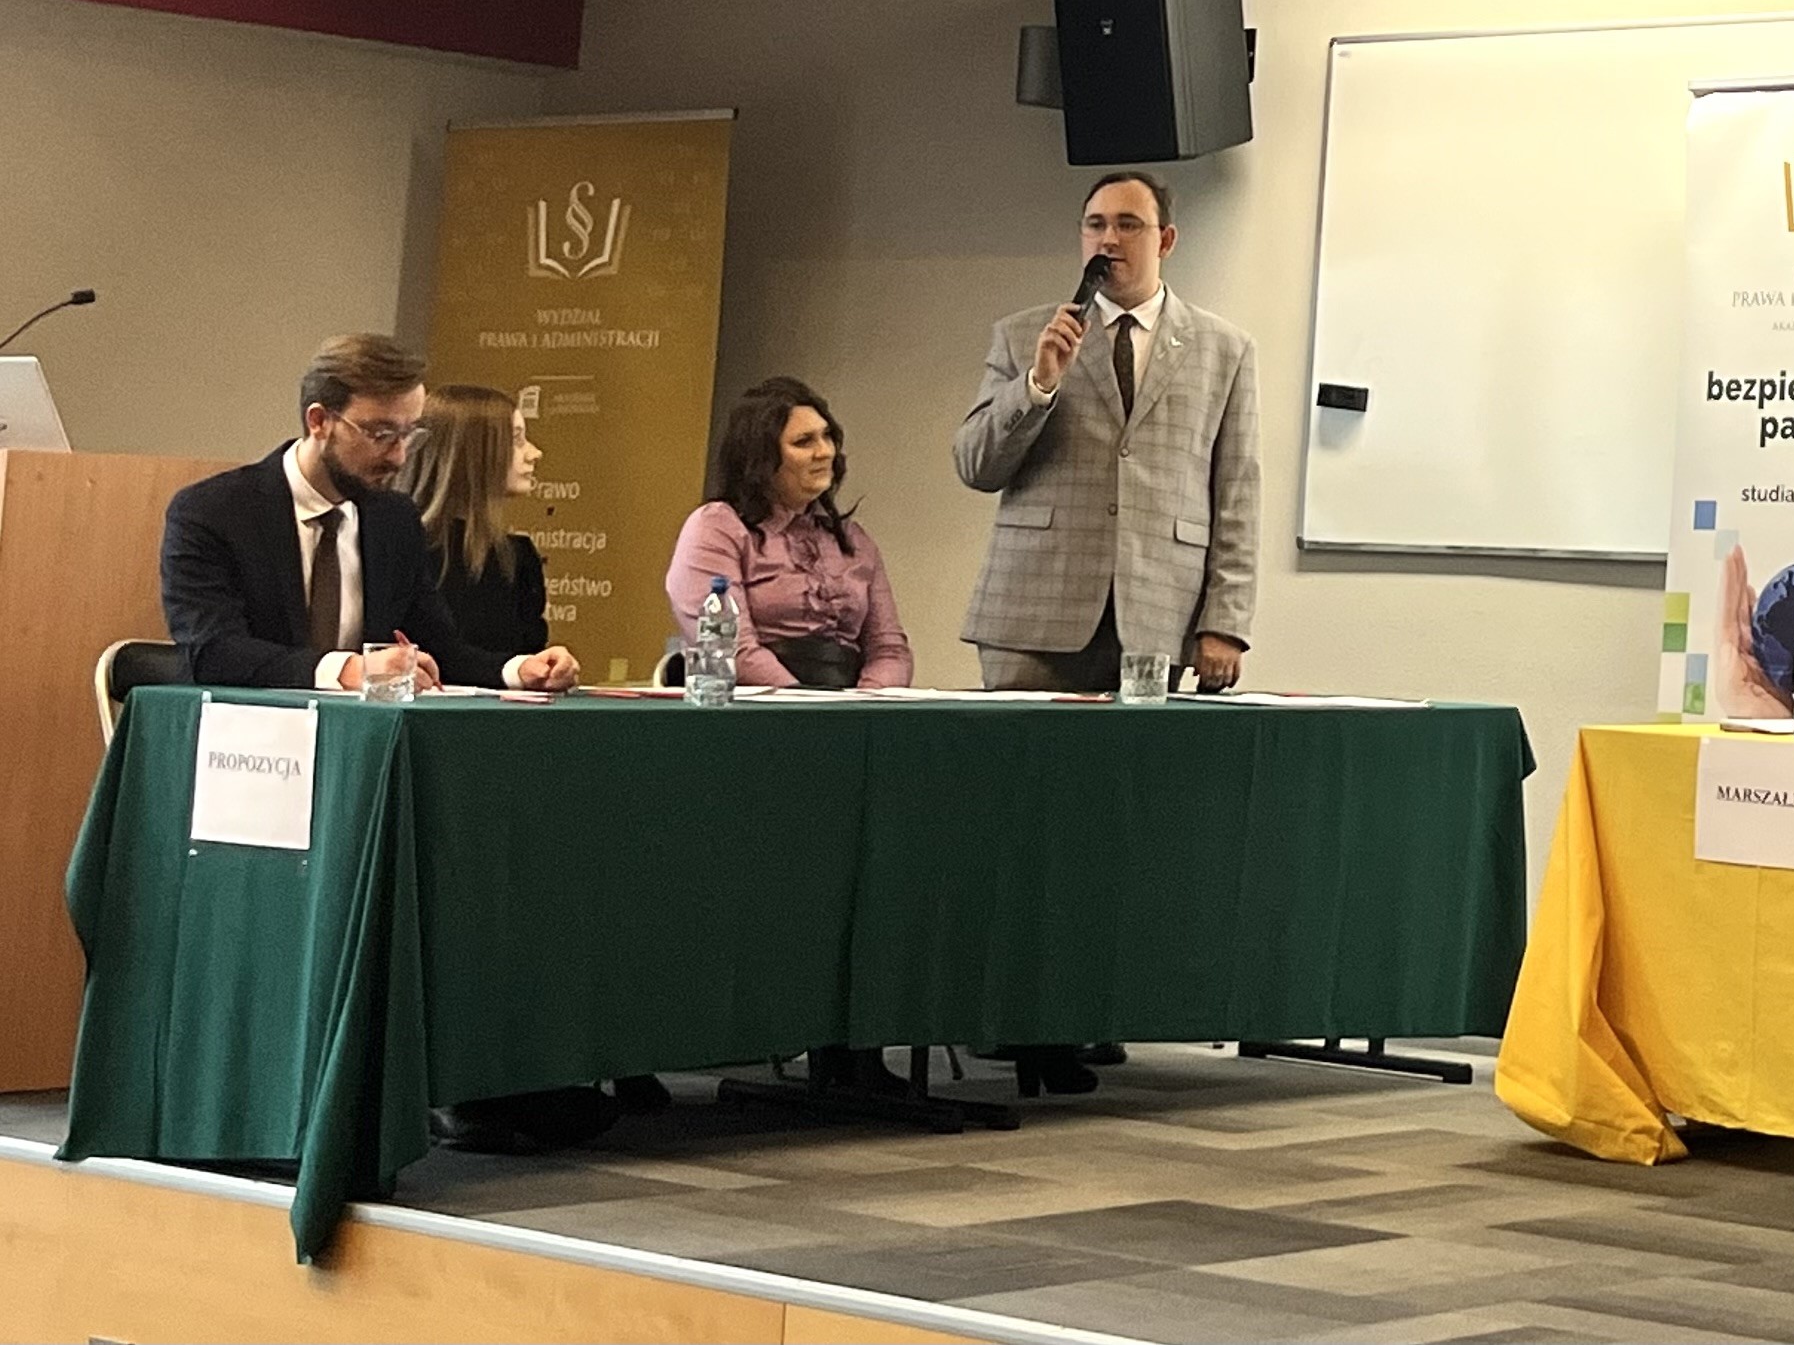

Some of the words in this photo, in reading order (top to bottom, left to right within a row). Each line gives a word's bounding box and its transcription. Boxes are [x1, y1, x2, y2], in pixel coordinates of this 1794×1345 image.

[1732, 291, 1786, 307] PRAWA
[1741, 485, 1794, 504] studia
[208, 751, 302, 781] PROPOZYCJA
